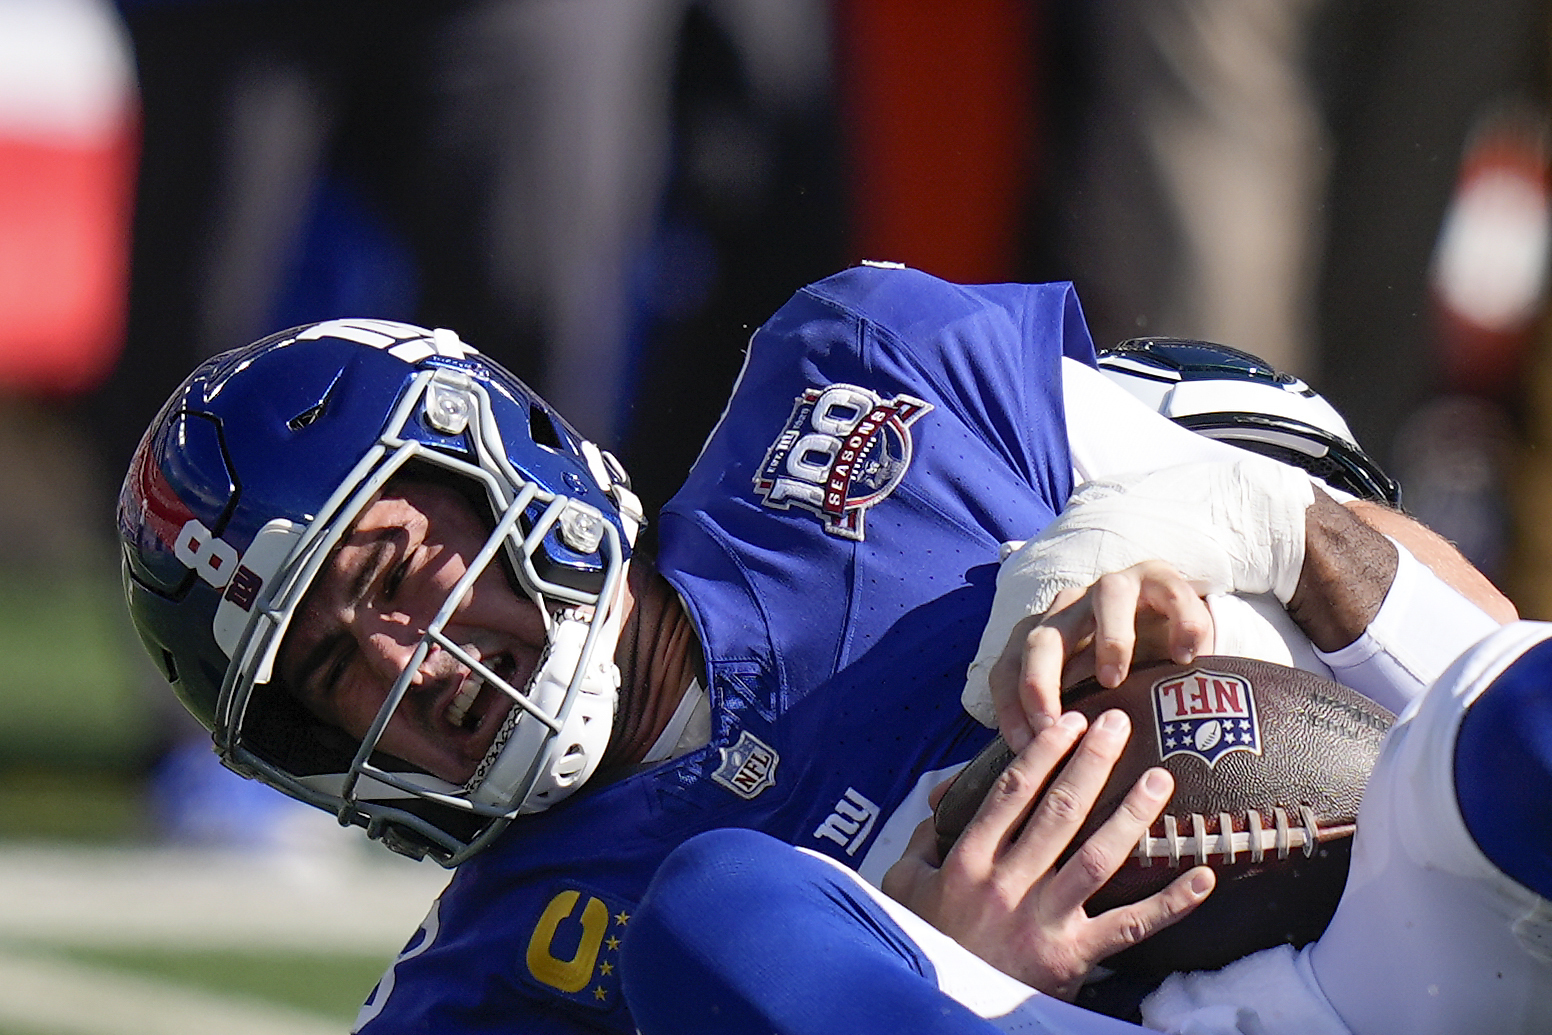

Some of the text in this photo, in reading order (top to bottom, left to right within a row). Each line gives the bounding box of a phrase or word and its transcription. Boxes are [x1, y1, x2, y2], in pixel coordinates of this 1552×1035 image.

[768, 386, 875, 507] 100
[828, 410, 886, 507] SEASONS
[174, 518, 240, 589] 8
[1162, 676, 1244, 717] NFL
[734, 752, 771, 791] NFL
[526, 889, 610, 994] C
